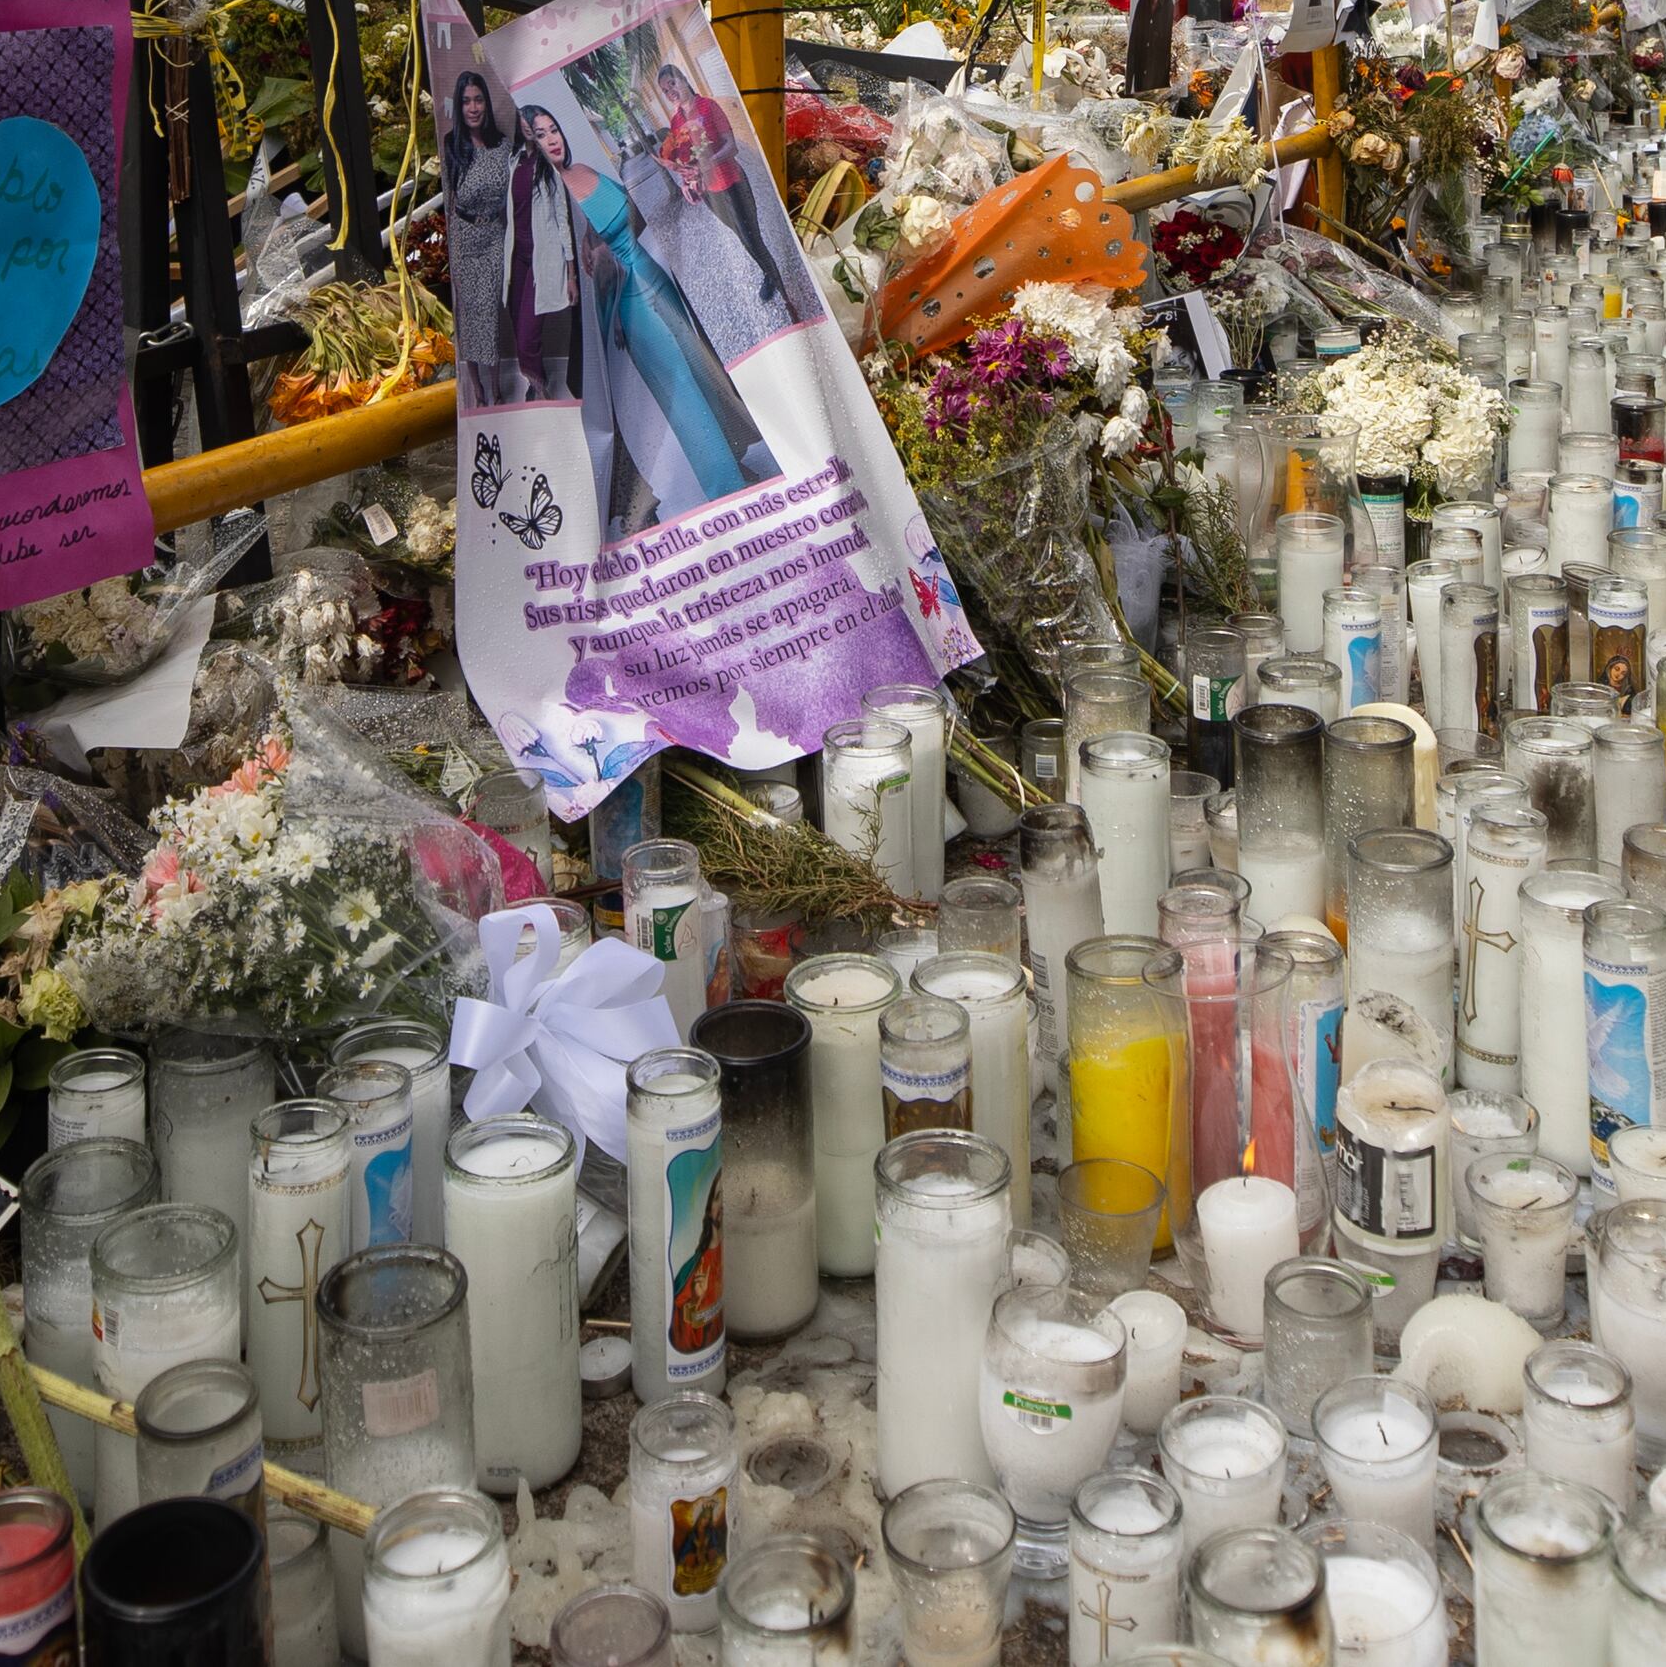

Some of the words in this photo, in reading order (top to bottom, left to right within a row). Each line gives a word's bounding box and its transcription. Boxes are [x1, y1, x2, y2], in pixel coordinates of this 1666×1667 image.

[0, 236, 71, 282] por
[58, 524, 97, 548] ser
[526, 605, 561, 630] Sus
[610, 564, 707, 618] quedaron
[707, 552, 735, 576] en
[736, 519, 818, 562] nuestro
[637, 525, 701, 568] brilla
[701, 511, 743, 539] con
[744, 494, 786, 522] más
[571, 638, 585, 663] y
[591, 618, 666, 652] aunque
[660, 610, 685, 634] la
[685, 574, 768, 624] tristeza
[768, 558, 809, 588] nos
[624, 660, 651, 678] su
[654, 645, 691, 672] luz
[688, 624, 744, 666] jamás
[745, 613, 771, 636] se
[771, 573, 857, 628] apagará.
[715, 662, 750, 695] por
[749, 623, 832, 673] siempre
[834, 612, 859, 635] en
[860, 595, 877, 623] el
